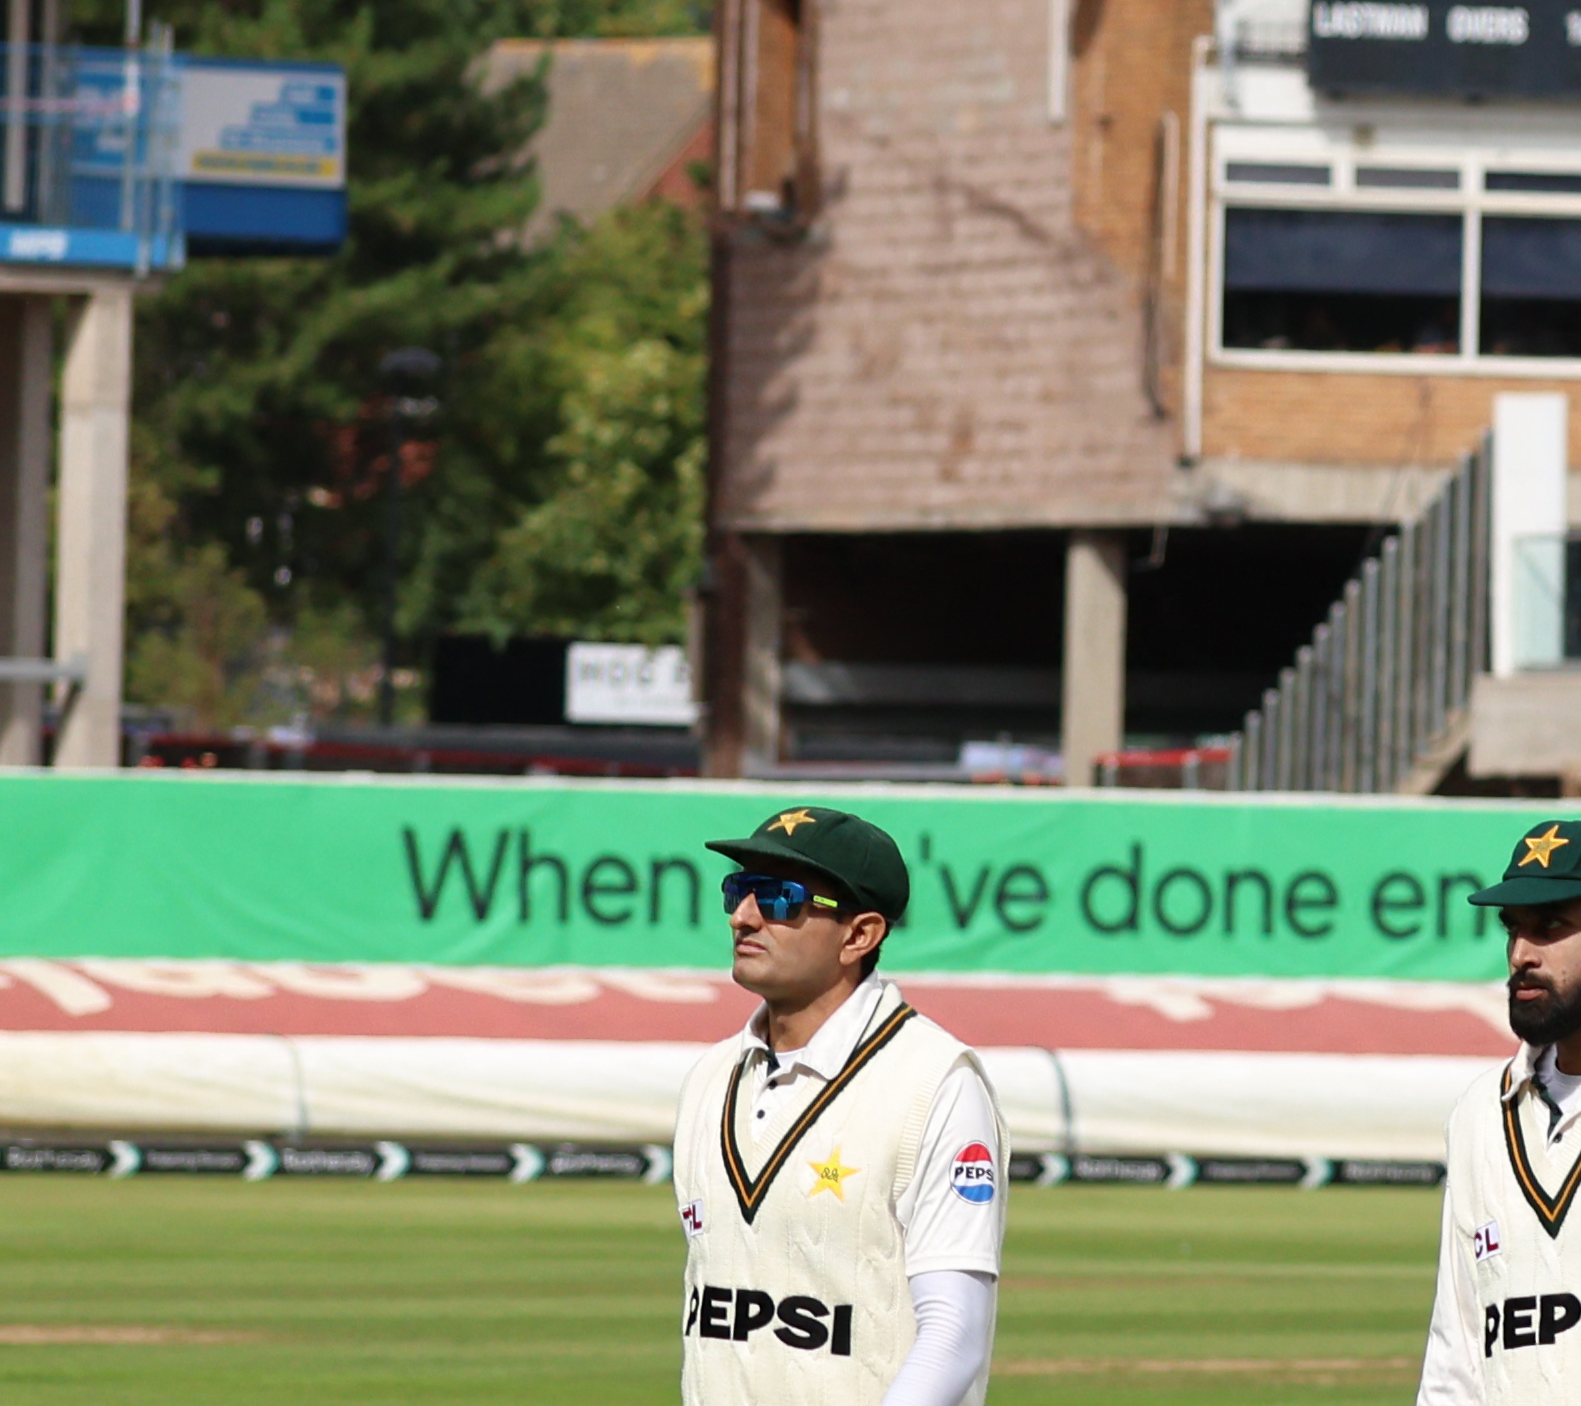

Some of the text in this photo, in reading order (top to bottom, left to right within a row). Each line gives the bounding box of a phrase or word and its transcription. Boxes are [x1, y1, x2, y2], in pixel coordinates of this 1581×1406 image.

[1446, 5, 1530, 45] OVERS
[403, 825, 701, 925] When
[1080, 845, 1340, 939] done
[954, 1165, 994, 1182] PEPS
[1475, 1227, 1499, 1260] CL
